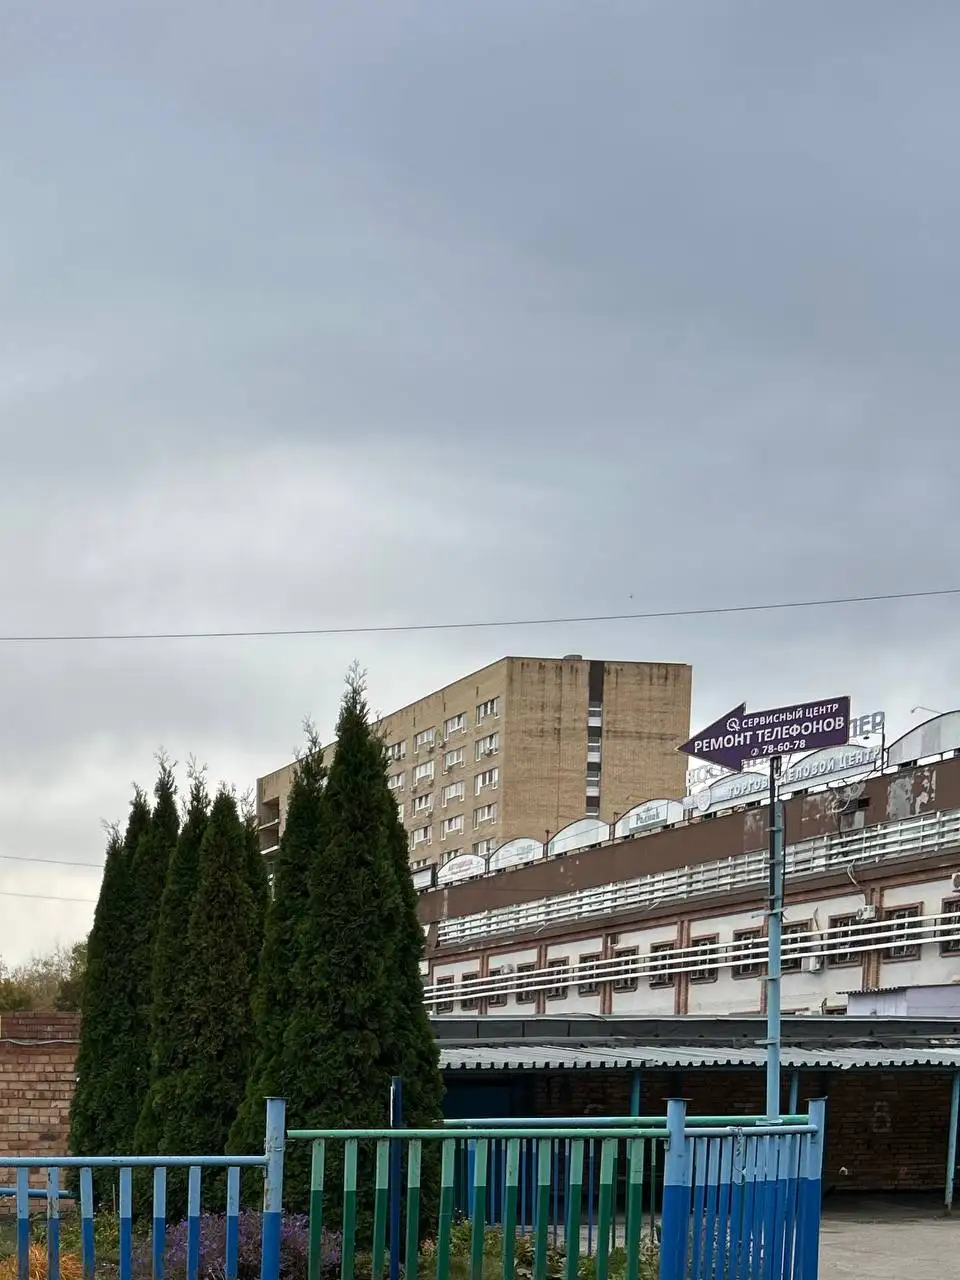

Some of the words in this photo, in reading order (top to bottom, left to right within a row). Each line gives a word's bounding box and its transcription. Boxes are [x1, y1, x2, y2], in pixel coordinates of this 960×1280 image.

[741, 707, 803, 728] СЕРВИСНЫЙ
[805, 702, 839, 719] ЦЕНТР
[694, 731, 753, 753] РЕМОНТ
[755, 716, 845, 743] ТЕЛЕФОНОВ
[762, 739, 806, 755] 78-60-78
[839, 745, 882, 769] ЦЕНТР
